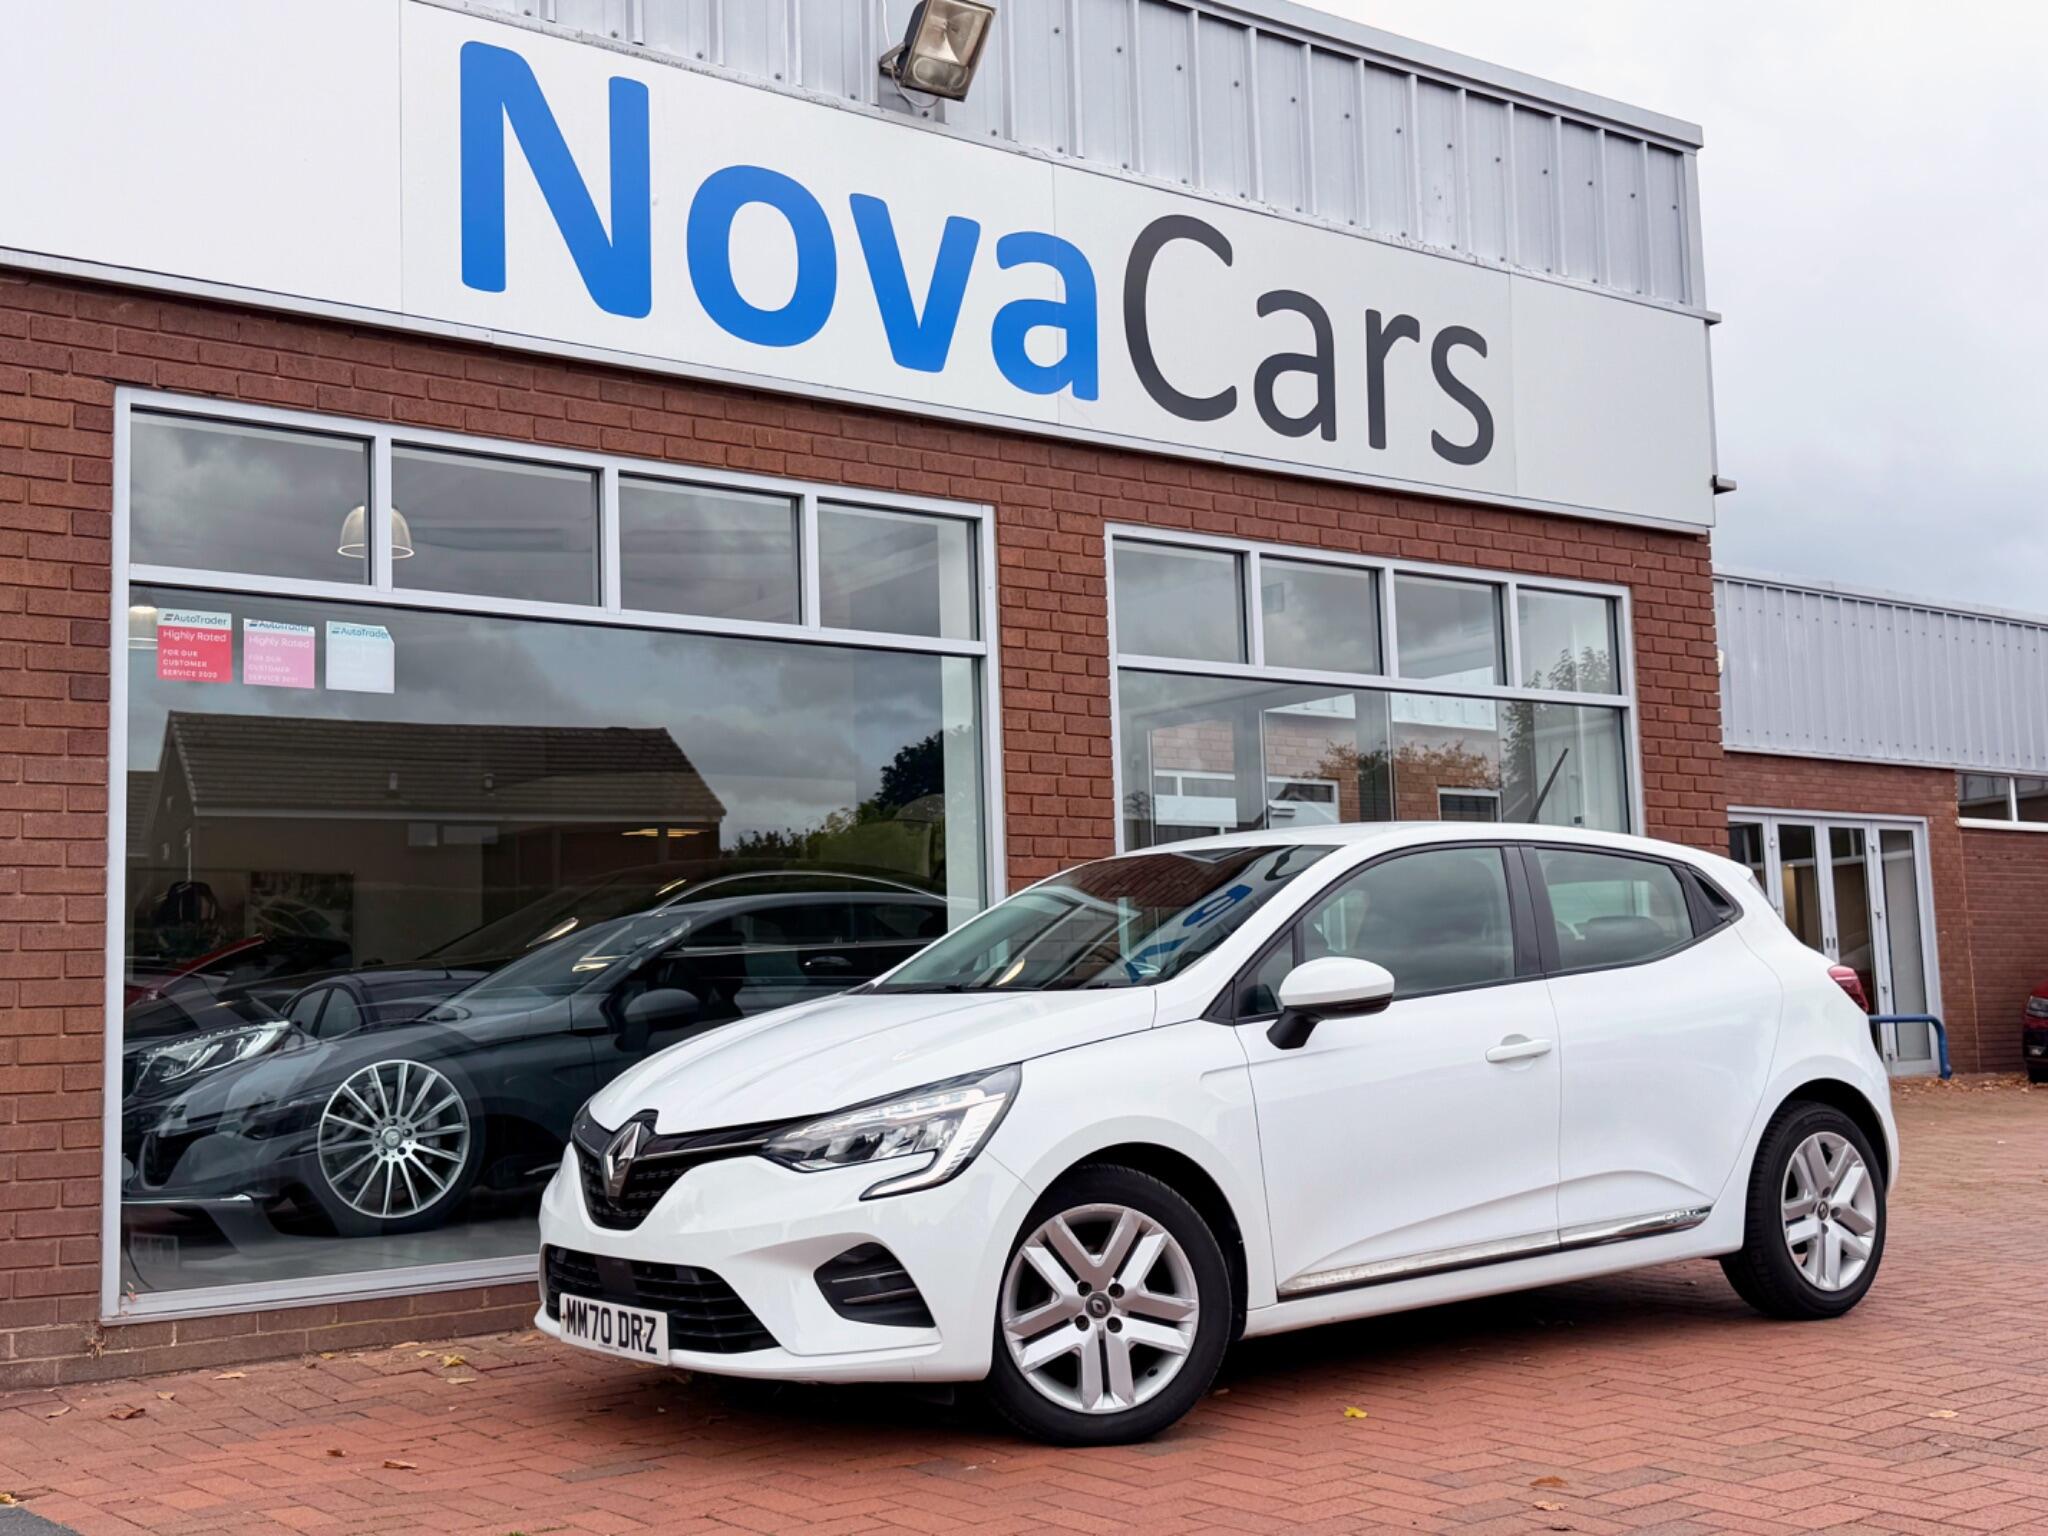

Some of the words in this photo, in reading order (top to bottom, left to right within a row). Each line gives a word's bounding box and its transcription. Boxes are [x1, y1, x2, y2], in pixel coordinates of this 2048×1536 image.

[173, 614, 227, 625] AutoTrader
[163, 629, 195, 642] Highly
[197, 631, 226, 642] Rated
[248, 635, 279, 648] Highly
[281, 637, 310, 648] Rated
[163, 649, 179, 657] FOR
[181, 649, 198, 657] OUR
[163, 659, 207, 668] CUSTOMER
[163, 669, 196, 677] SERVICE
[566, 1298, 612, 1344] MM70
[618, 1310, 658, 1355] DRZ
